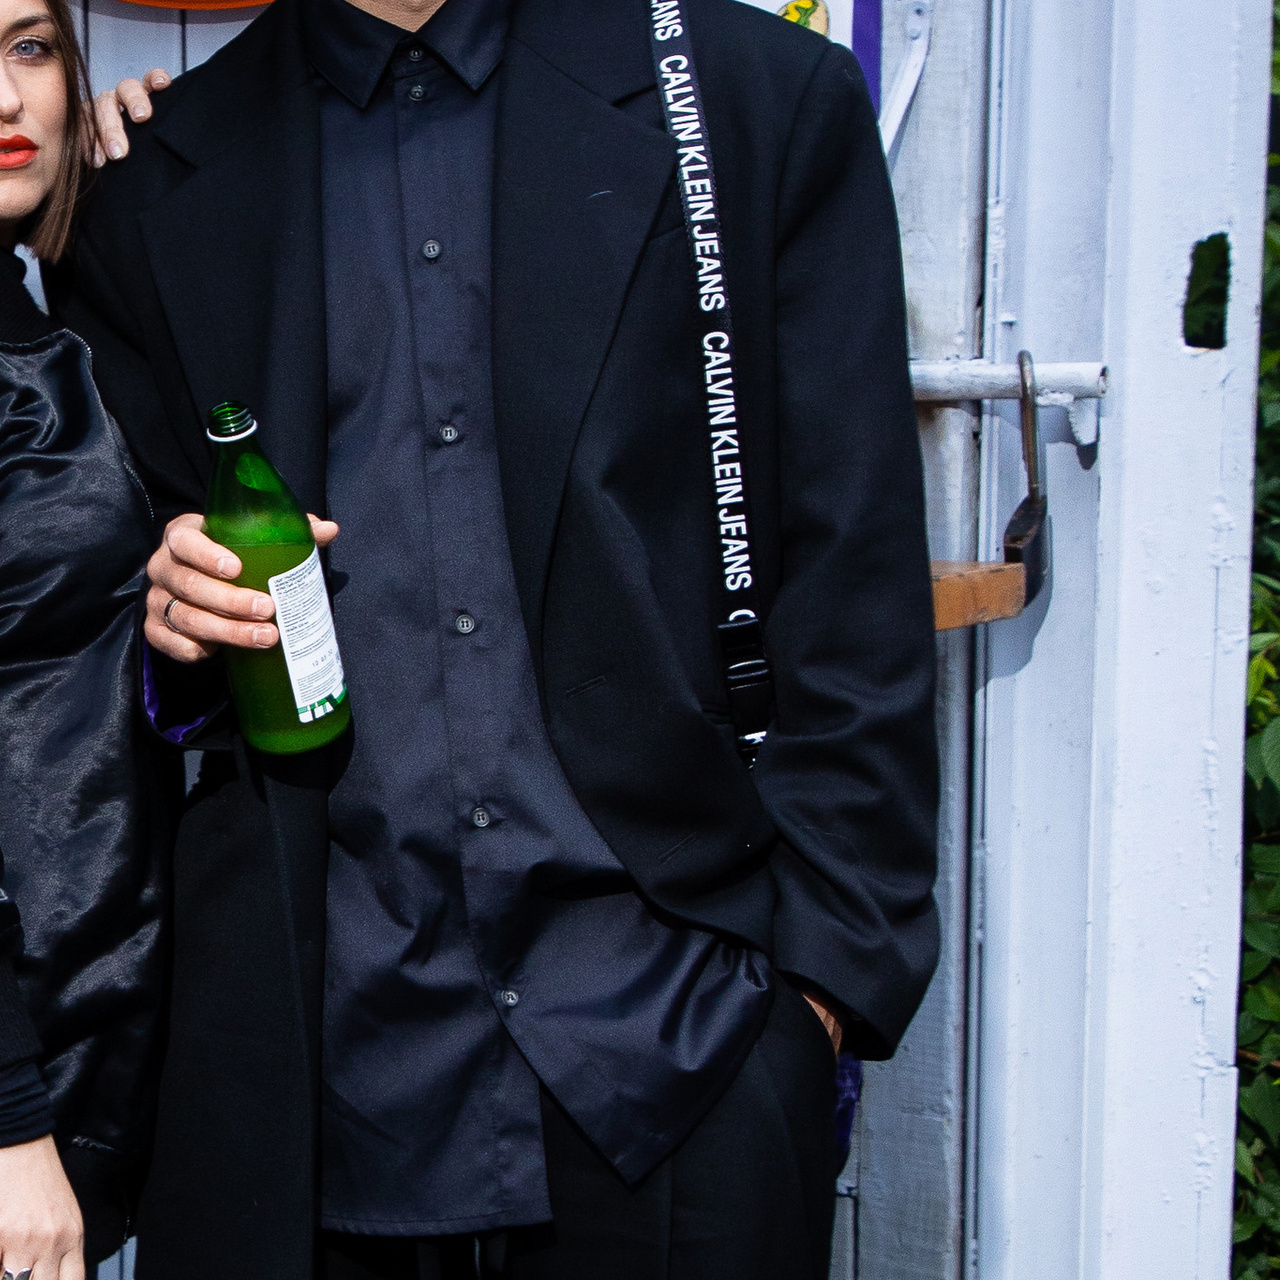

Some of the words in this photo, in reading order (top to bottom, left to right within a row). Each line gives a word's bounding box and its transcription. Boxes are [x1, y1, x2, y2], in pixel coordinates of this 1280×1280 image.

[659, 54, 703, 142] CALVIN
[676, 145, 716, 221] KLEIN
[692, 225, 726, 312] JEANS
[702, 331, 737, 425] CALVIN
[710, 429, 744, 505] KLEIN
[718, 507, 753, 591] JEANS
